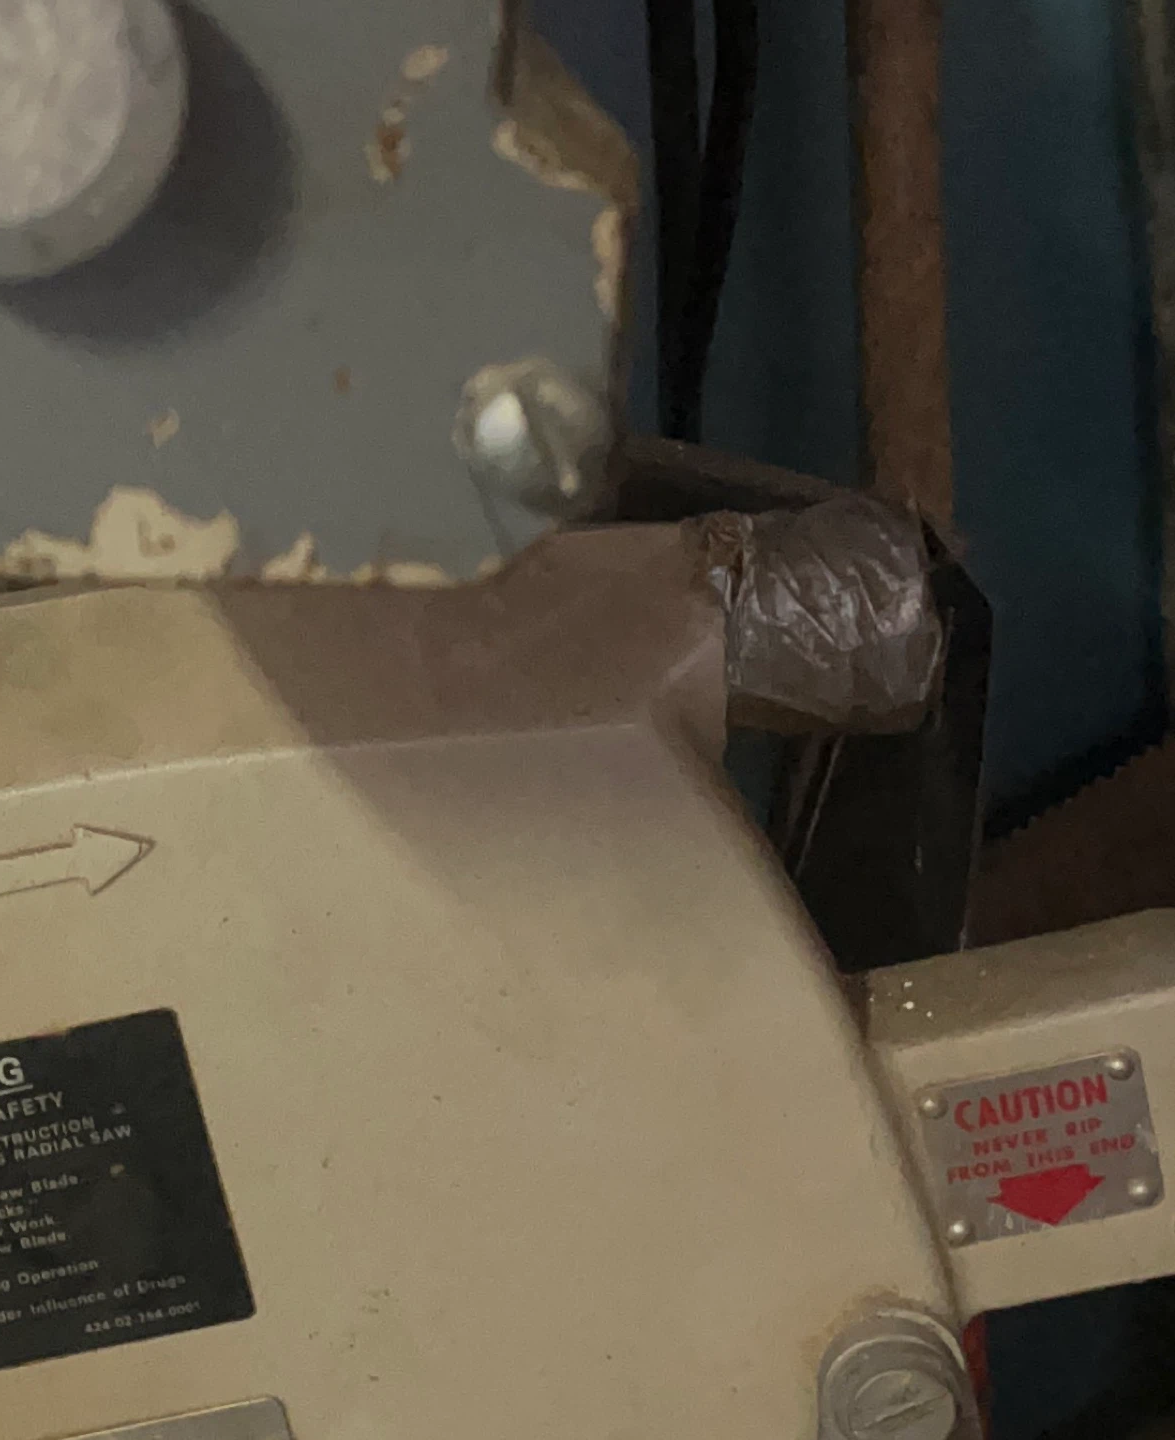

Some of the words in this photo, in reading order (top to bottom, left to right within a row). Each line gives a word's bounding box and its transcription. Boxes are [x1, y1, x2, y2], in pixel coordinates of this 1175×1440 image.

[953, 1073, 1108, 1133] CAUTION
[12, 1135, 84, 1162] RADIAL
[88, 1124, 131, 1144] SAW
[972, 1128, 1048, 1157] NEVER
[1065, 1116, 1103, 1137] RIP
[946, 1158, 1013, 1185] FROM
[1027, 1145, 1075, 1168] THIS
[1089, 1132, 1136, 1156] END
[16, 1259, 99, 1285] Operation
[29, 1290, 106, 1315] Influence
